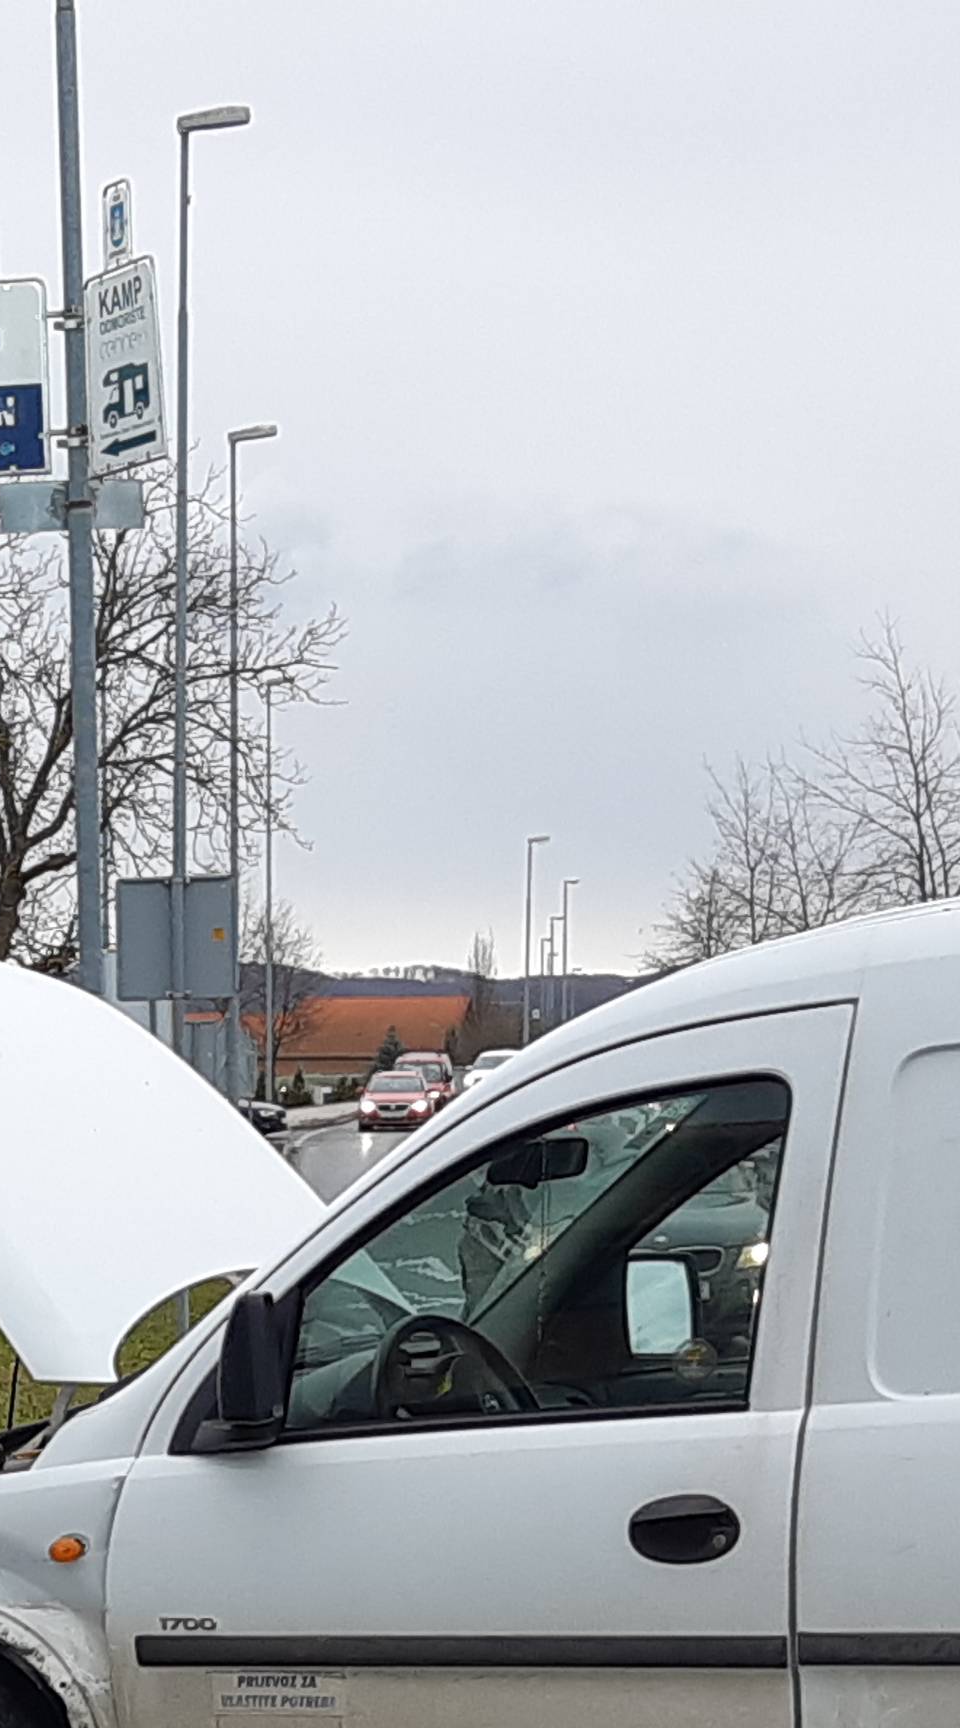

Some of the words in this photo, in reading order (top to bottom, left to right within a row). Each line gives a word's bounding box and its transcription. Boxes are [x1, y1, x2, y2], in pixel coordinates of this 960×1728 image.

[98, 275, 142, 319] KAMP
[158, 1617, 217, 1631] 1700
[237, 1675, 298, 1689] PRIJEVOZ
[300, 1675, 318, 1689] ZA
[220, 1695, 278, 1708] VLASTITE
